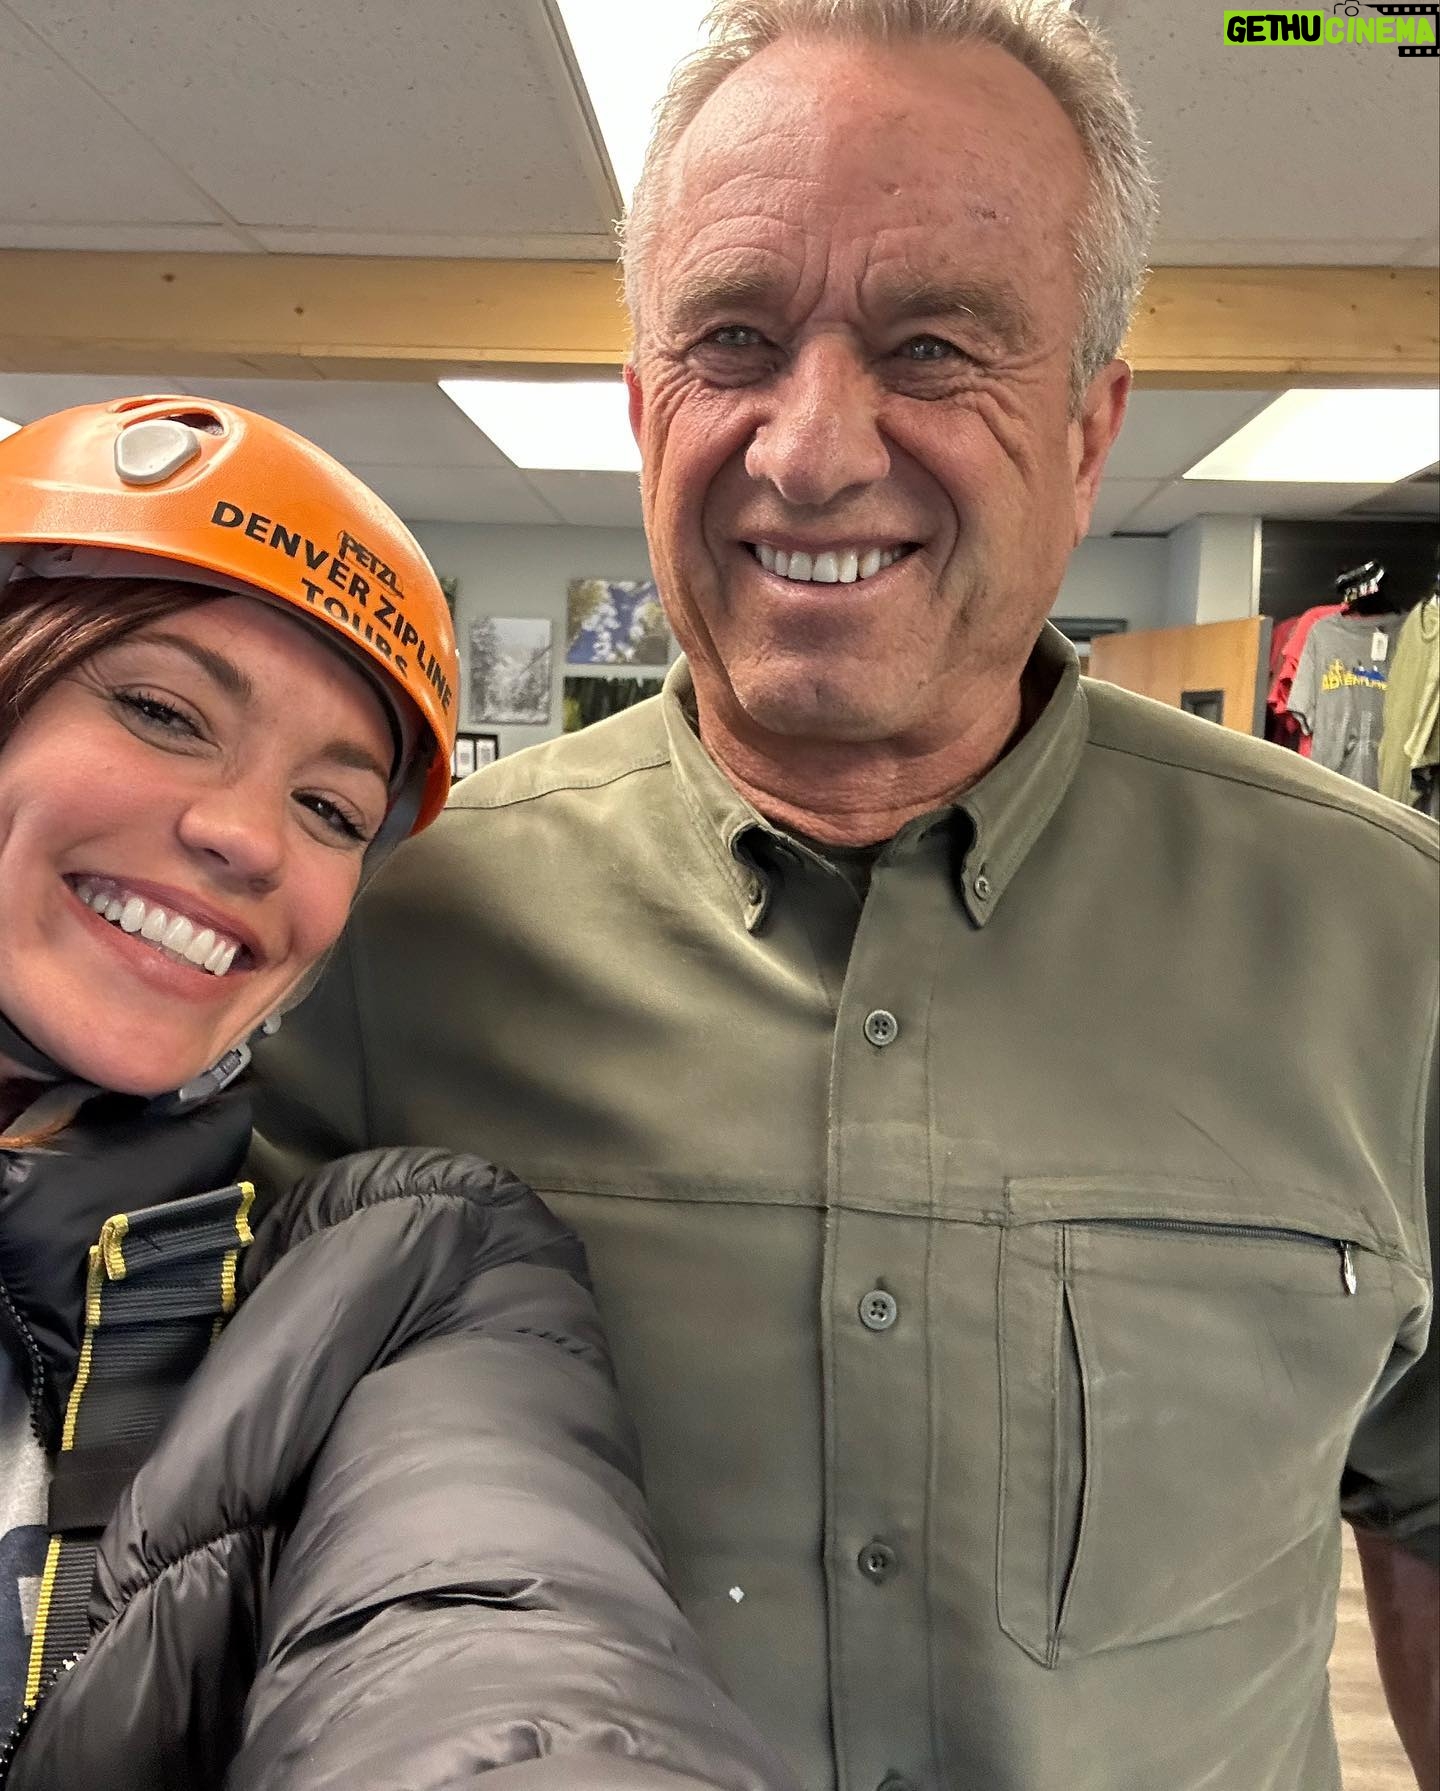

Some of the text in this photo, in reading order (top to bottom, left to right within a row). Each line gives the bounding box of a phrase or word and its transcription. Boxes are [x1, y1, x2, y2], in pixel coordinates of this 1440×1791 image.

[210, 501, 452, 716] DENVER ZIPLINE
[339, 530, 404, 600] PETZL
[301, 578, 408, 679] TOURS
